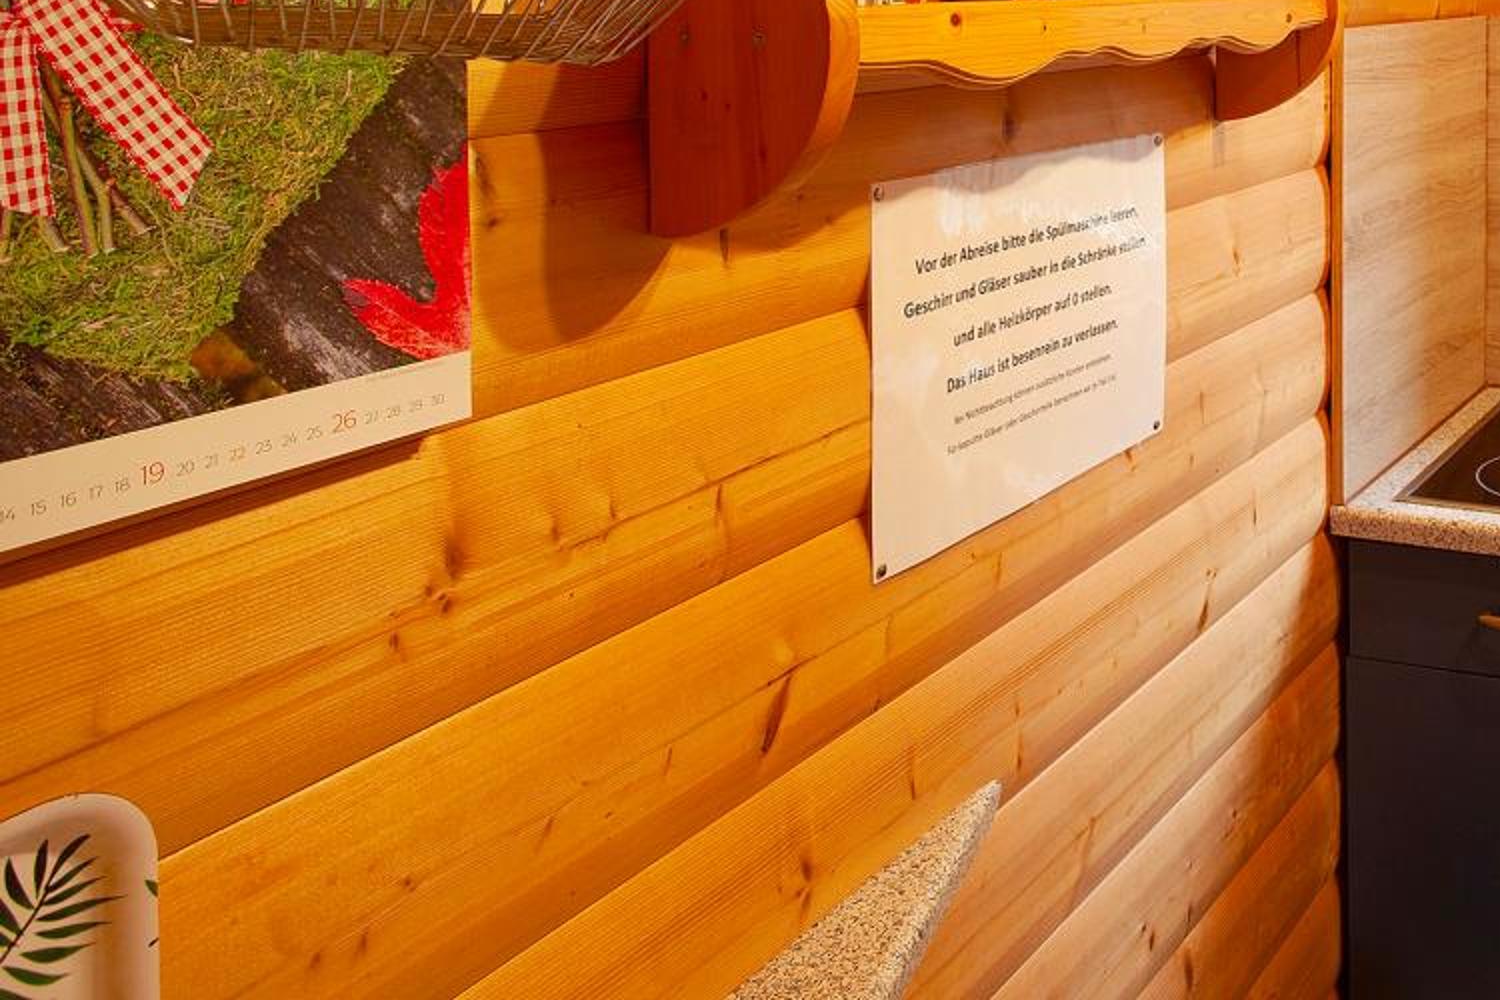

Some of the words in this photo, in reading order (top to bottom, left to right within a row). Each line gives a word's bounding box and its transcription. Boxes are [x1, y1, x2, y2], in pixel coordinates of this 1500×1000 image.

[914, 258, 938, 275] Vor
[939, 251, 957, 269] der
[960, 240, 1000, 262] Abreise
[1001, 234, 1027, 251] bitte
[1028, 227, 1044, 244] die
[903, 292, 953, 319] Geschirr
[955, 281, 977, 303] und
[978, 275, 1012, 295] Gläser
[1013, 265, 1048, 285] sauber
[1049, 259, 1059, 273] in
[1061, 255, 1077, 271] die
[1077, 243, 1117, 267] Schränke
[953, 325, 975, 347] und
[977, 319, 997, 338] alle
[998, 303, 1053, 330] Heizkörper
[1054, 292, 1071, 312] auf
[1072, 292, 1079, 307] 0
[946, 375, 967, 394] Das
[969, 362, 996, 384] Haus
[997, 356, 1011, 373] ist
[1062, 335, 1073, 350] zu
[30, 499, 47, 517] 15
[59, 491, 77, 508] 16
[88, 484, 103, 500] 17
[114, 477, 131, 494] 18
[140, 460, 165, 486] 19
[176, 459, 195, 477] 20
[205, 453, 219, 469] 21
[229, 445, 246, 462] 22
[255, 439, 273, 455] 23
[282, 432, 298, 448] 24
[305, 424, 323, 441] 25
[331, 408, 358, 434] 26
